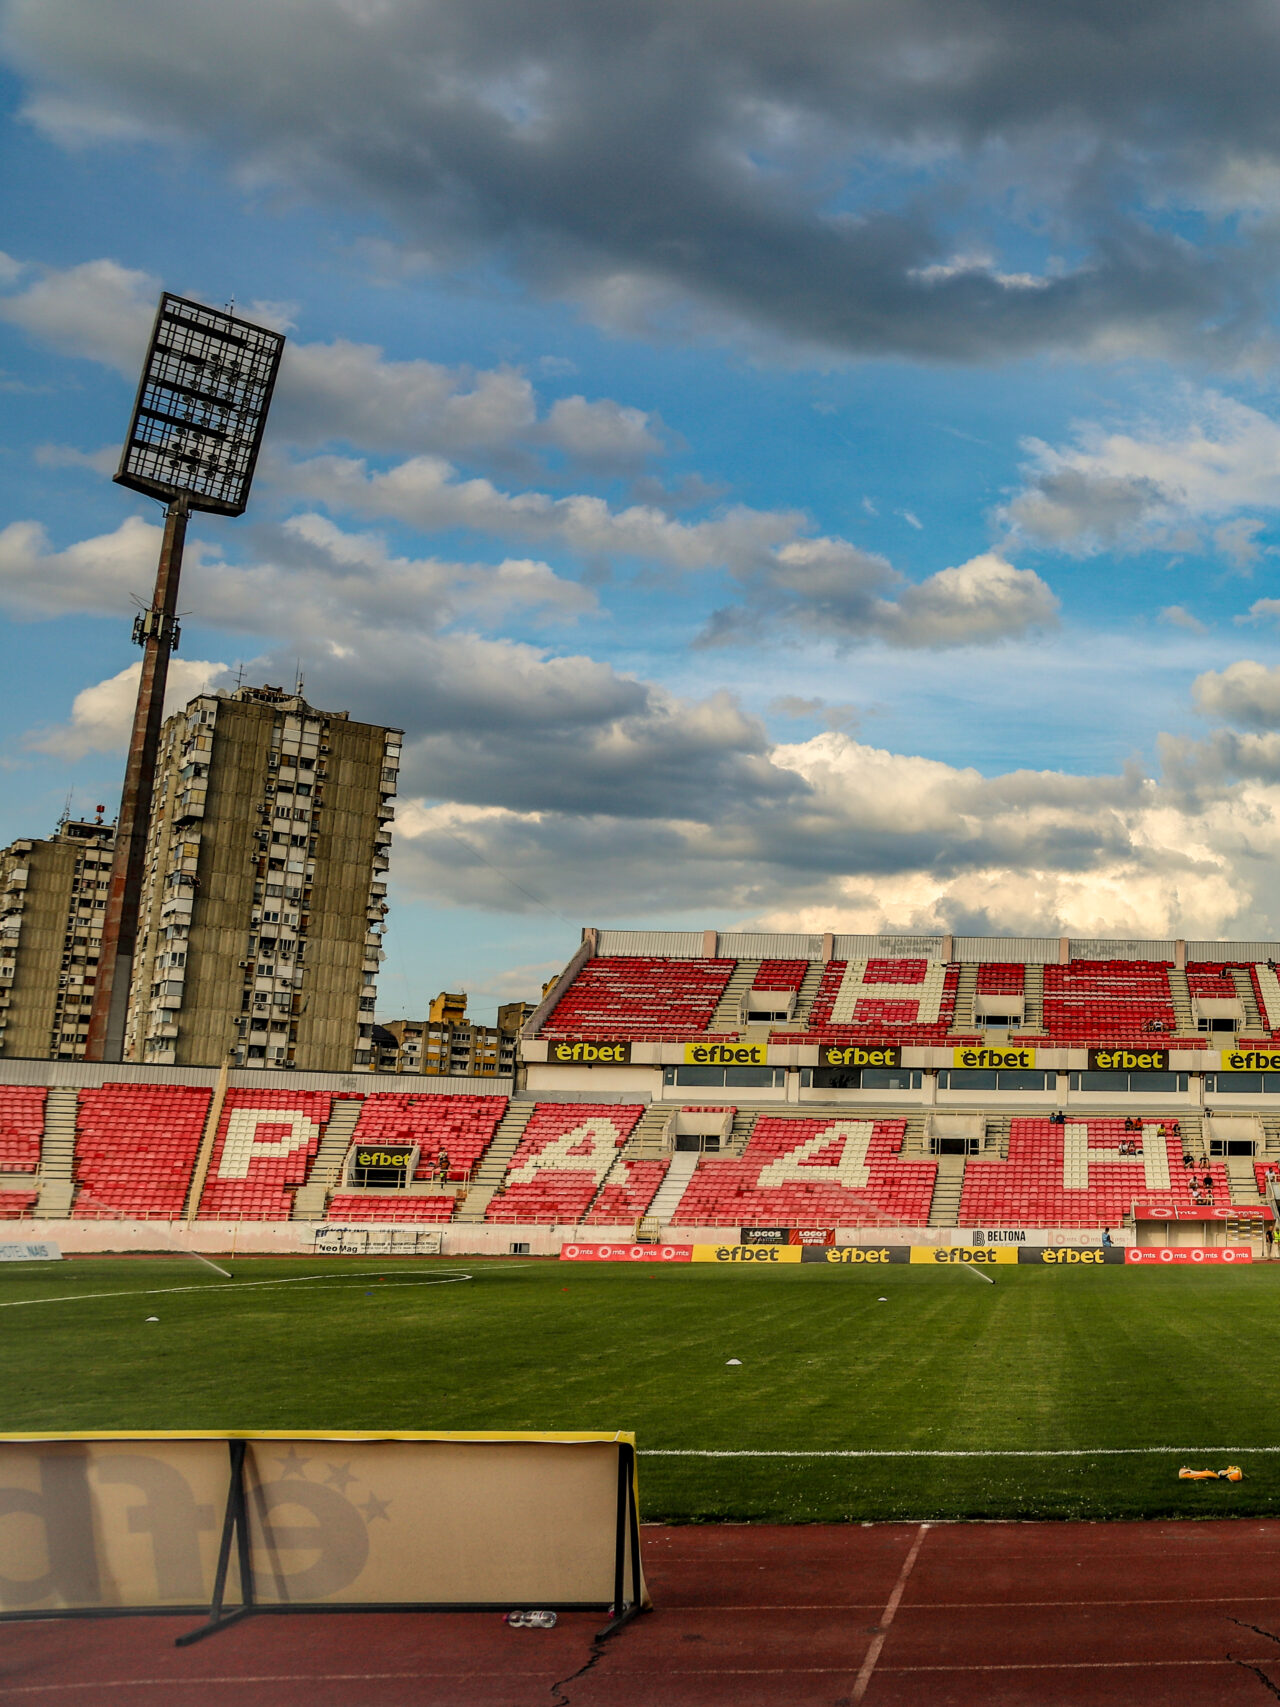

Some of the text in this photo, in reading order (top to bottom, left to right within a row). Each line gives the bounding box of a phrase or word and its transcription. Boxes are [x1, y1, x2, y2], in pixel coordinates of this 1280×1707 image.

[555, 1043, 624, 1061] efbet
[691, 1046, 760, 1063] efbet
[826, 1047, 895, 1065] efbet
[961, 1050, 1029, 1067] efbet
[1095, 1051, 1163, 1068] efbet
[987, 1230, 1026, 1242] BELTONA
[319, 1244, 338, 1252] Neo
[340, 1244, 358, 1253] Mag
[643, 1249, 657, 1257] mts
[715, 1246, 780, 1261] efbet
[825, 1247, 890, 1263] efbet
[933, 1247, 997, 1263] efbet
[1041, 1248, 1105, 1264] efbet
